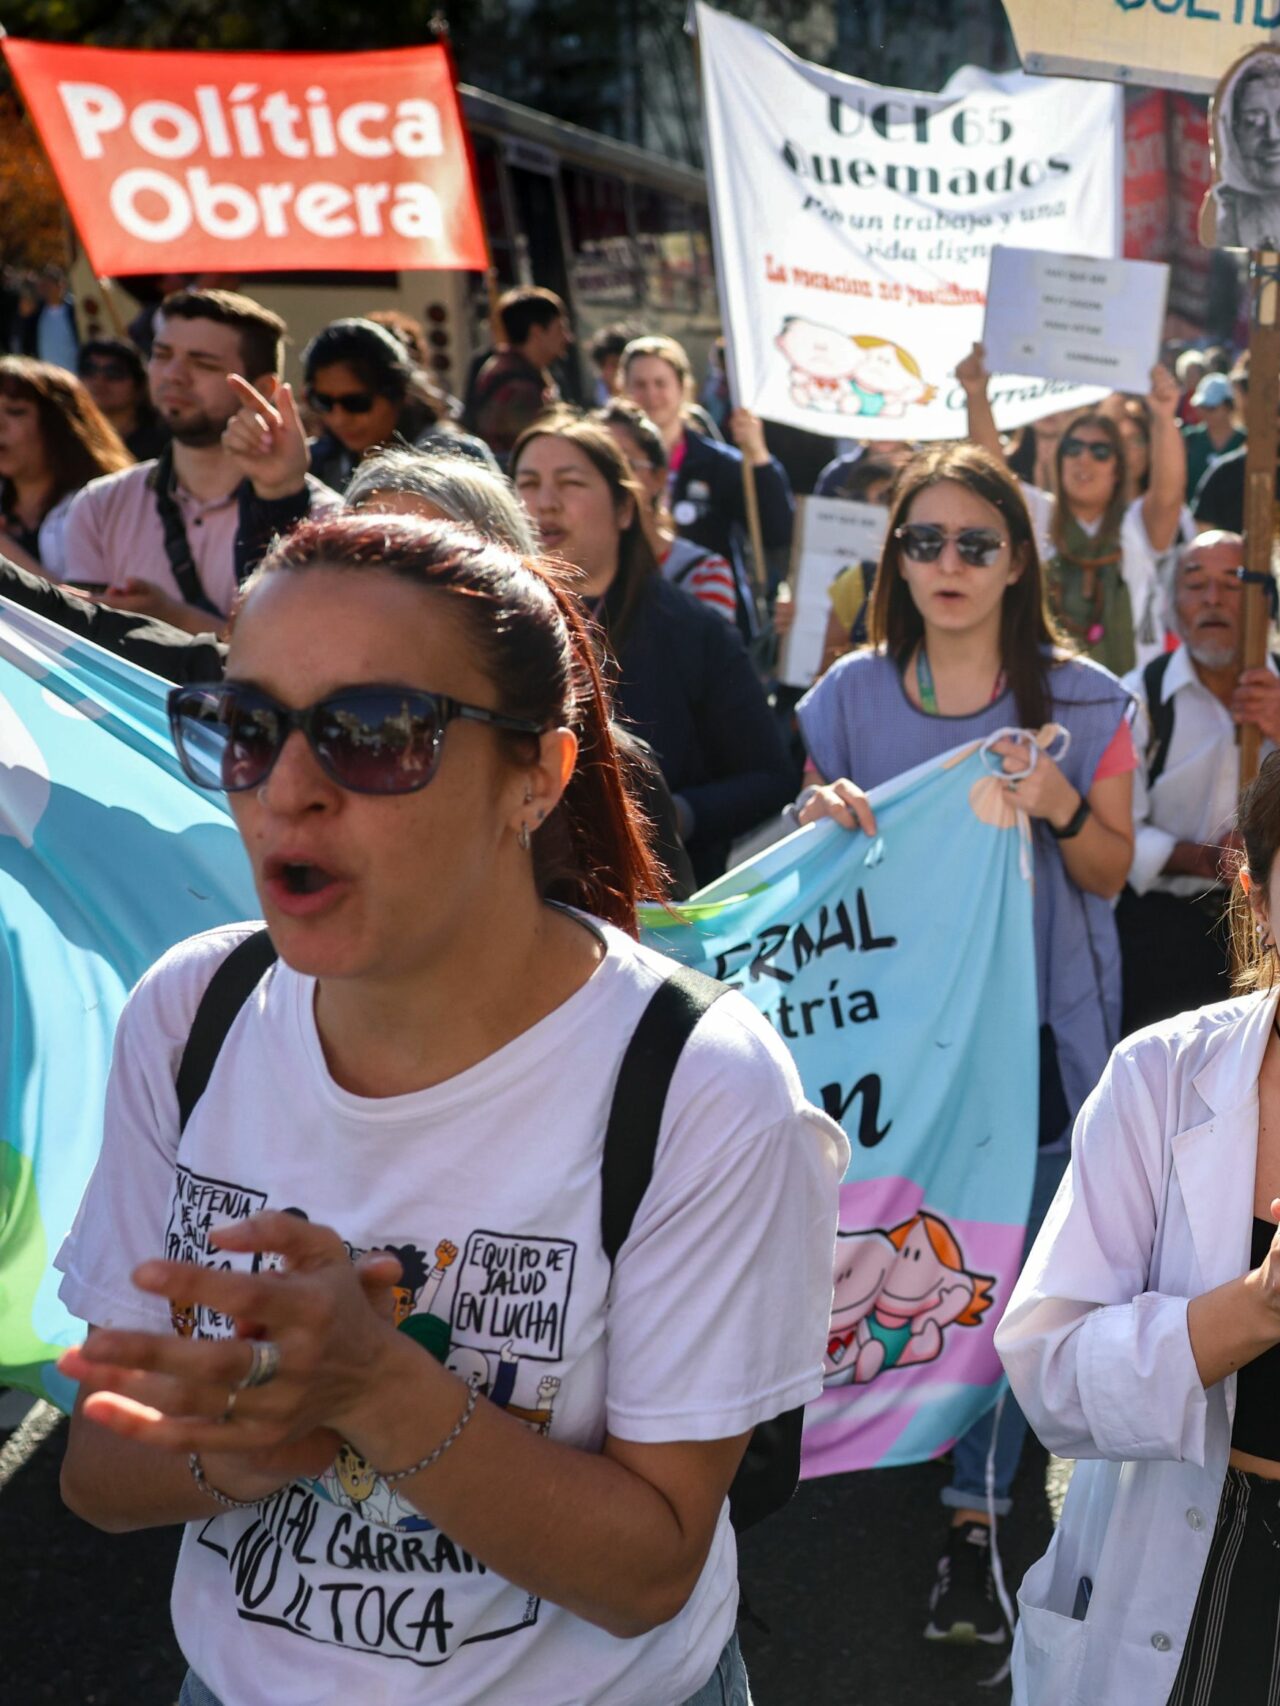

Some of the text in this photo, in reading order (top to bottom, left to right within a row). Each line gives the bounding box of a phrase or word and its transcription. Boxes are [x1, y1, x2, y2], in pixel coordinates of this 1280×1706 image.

[57, 81, 445, 161] Política
[950, 105, 1014, 147] 65
[109, 168, 442, 243] Obrera
[849, 213, 883, 231] un
[926, 238, 991, 264] dign
[714, 887, 899, 990] ERNAL
[766, 979, 881, 1039] tría
[545, 1247, 571, 1272] DE
[455, 1292, 558, 1352] EN LUCHA
[318, 1582, 454, 1654] TOCA
